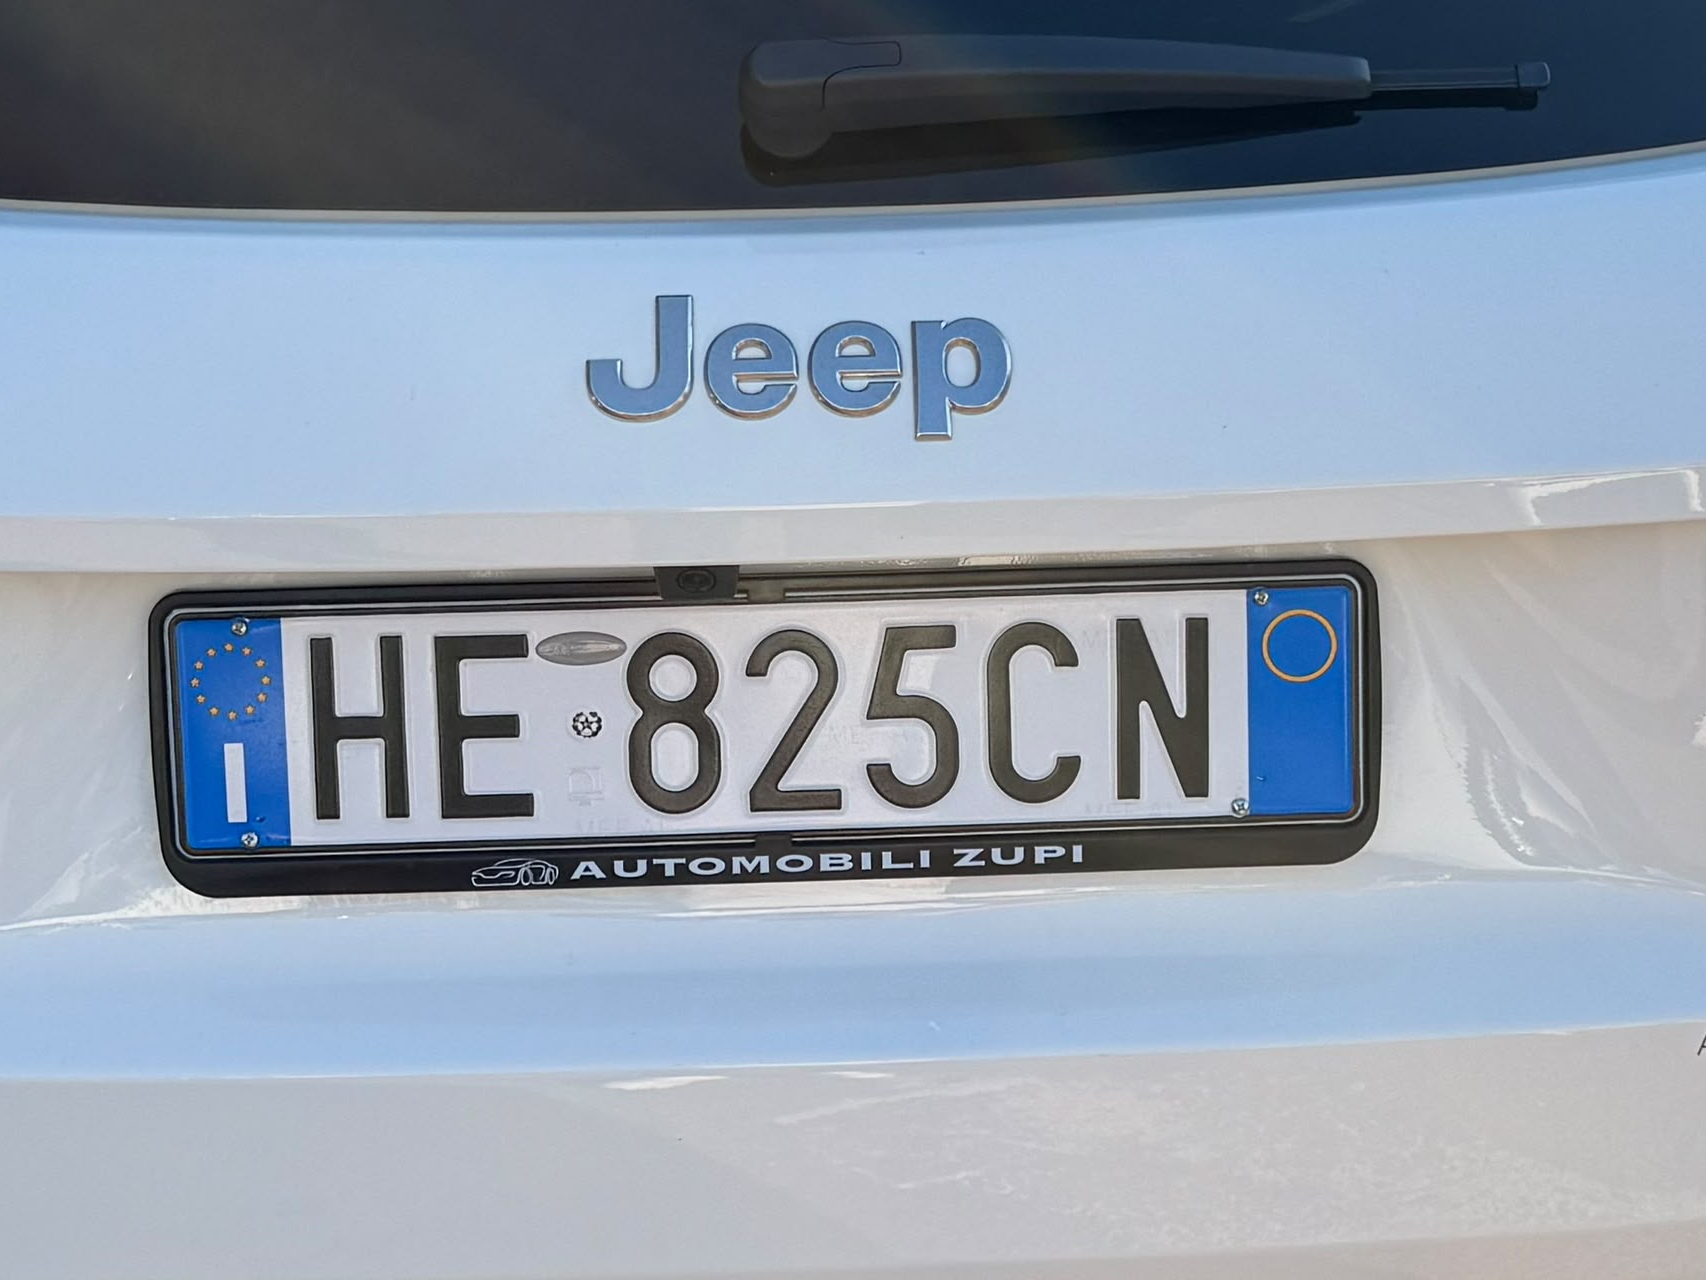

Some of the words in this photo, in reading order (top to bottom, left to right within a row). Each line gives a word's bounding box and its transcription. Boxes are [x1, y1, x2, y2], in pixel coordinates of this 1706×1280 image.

[586, 294, 1013, 441] Jeep
[309, 633, 535, 820] HE
[626, 616, 1209, 815] 825CN
[223, 742, 249, 824] I
[569, 848, 932, 881] AUTOMOBILI
[952, 844, 1084, 868] ZUPI
